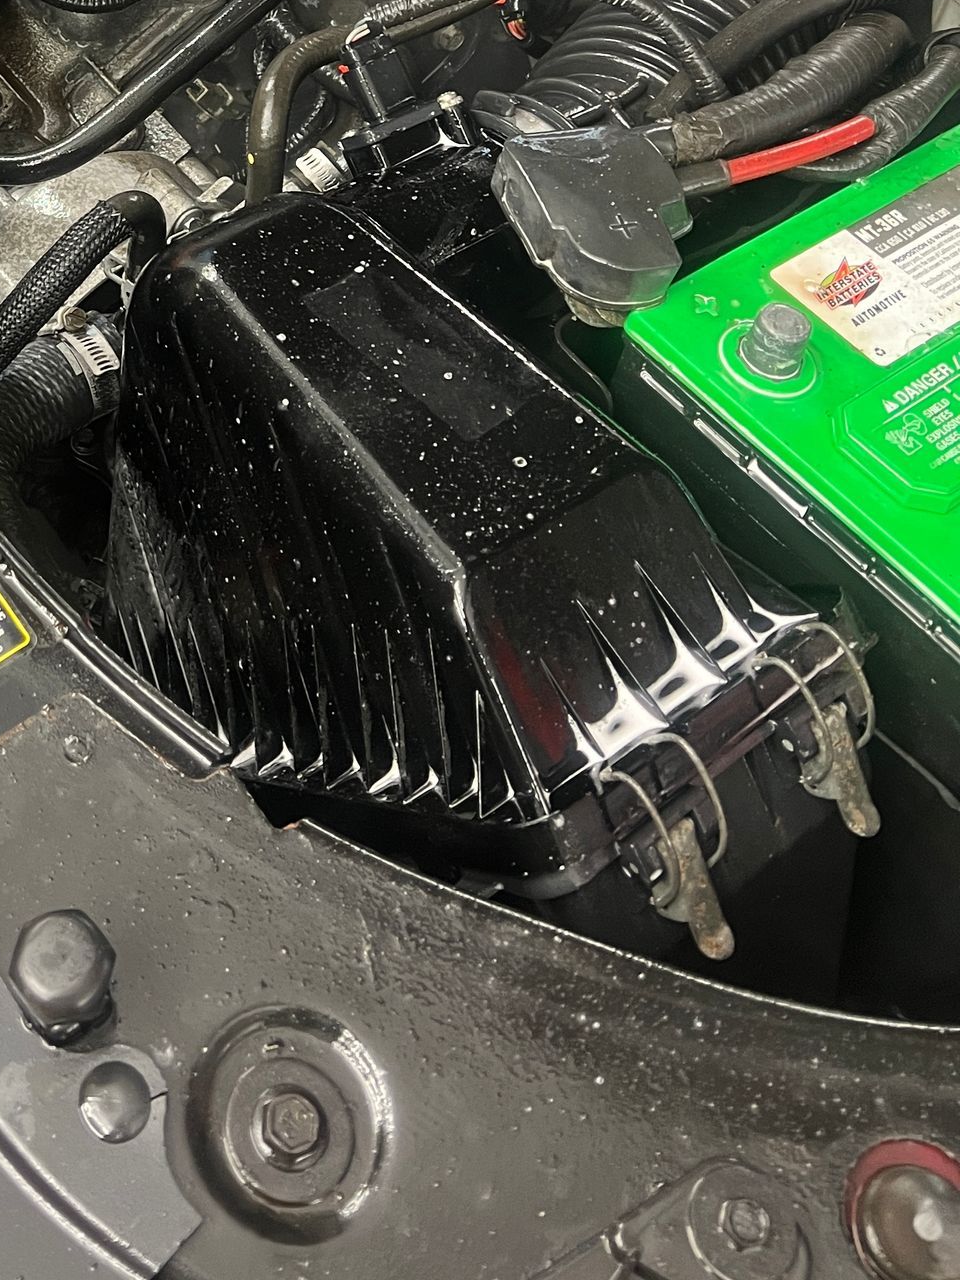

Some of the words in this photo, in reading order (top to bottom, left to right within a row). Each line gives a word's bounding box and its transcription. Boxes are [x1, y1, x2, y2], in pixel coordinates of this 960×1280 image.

[817, 261, 875, 300] INTERSTATE
[828, 272, 880, 307] BATTERIES
[851, 289, 907, 327] AUTOMOTIVE
[893, 362, 954, 405] DANGER
